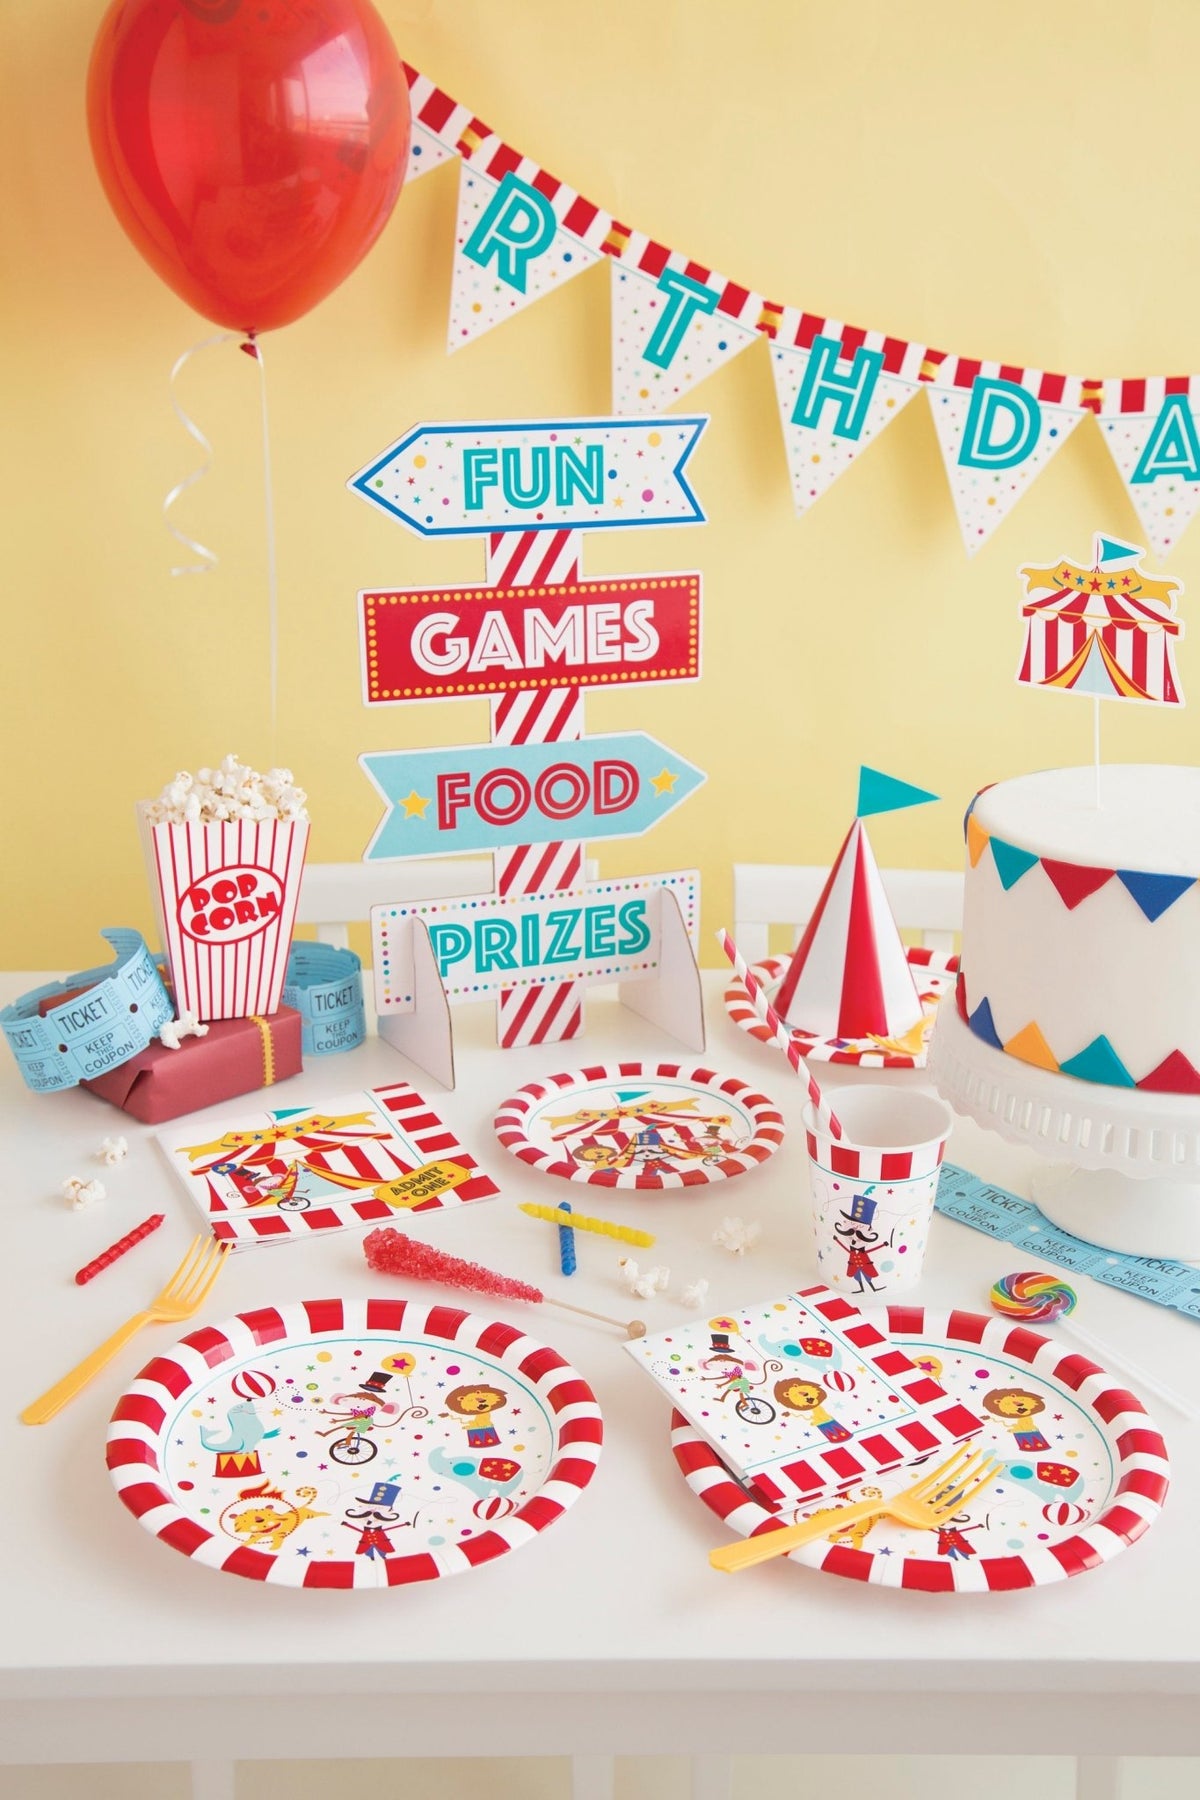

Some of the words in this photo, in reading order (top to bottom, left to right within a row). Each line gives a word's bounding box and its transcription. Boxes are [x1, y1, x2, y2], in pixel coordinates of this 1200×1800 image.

[463, 445, 604, 510] FUN
[410, 600, 660, 676] GAMES
[437, 759, 640, 830] FOOD
[188, 873, 258, 912] POP
[190, 891, 280, 935] CORN
[428, 900, 651, 977] PRIZES
[314, 985, 353, 1012] TICKET
[58, 997, 108, 1034] TICKET
[325, 1019, 350, 1034] KEEP
[85, 1032, 114, 1054] KEEP
[316, 1032, 358, 1051] COUPON
[85, 1041, 134, 1073] COUPON
[390, 1166, 444, 1196] ADMIT
[411, 1177, 451, 1197] ONE
[969, 1204, 1000, 1220] KEEP
[980, 1188, 1032, 1215] TICKET
[948, 1206, 999, 1232] COUPON
[1022, 1241, 1076, 1265] COUPON
[1043, 1238, 1077, 1253] KEEP
[1123, 1270, 1159, 1283] KEEP
[1134, 1257, 1191, 1278] TICKET
[1102, 1273, 1159, 1296] COUPON
